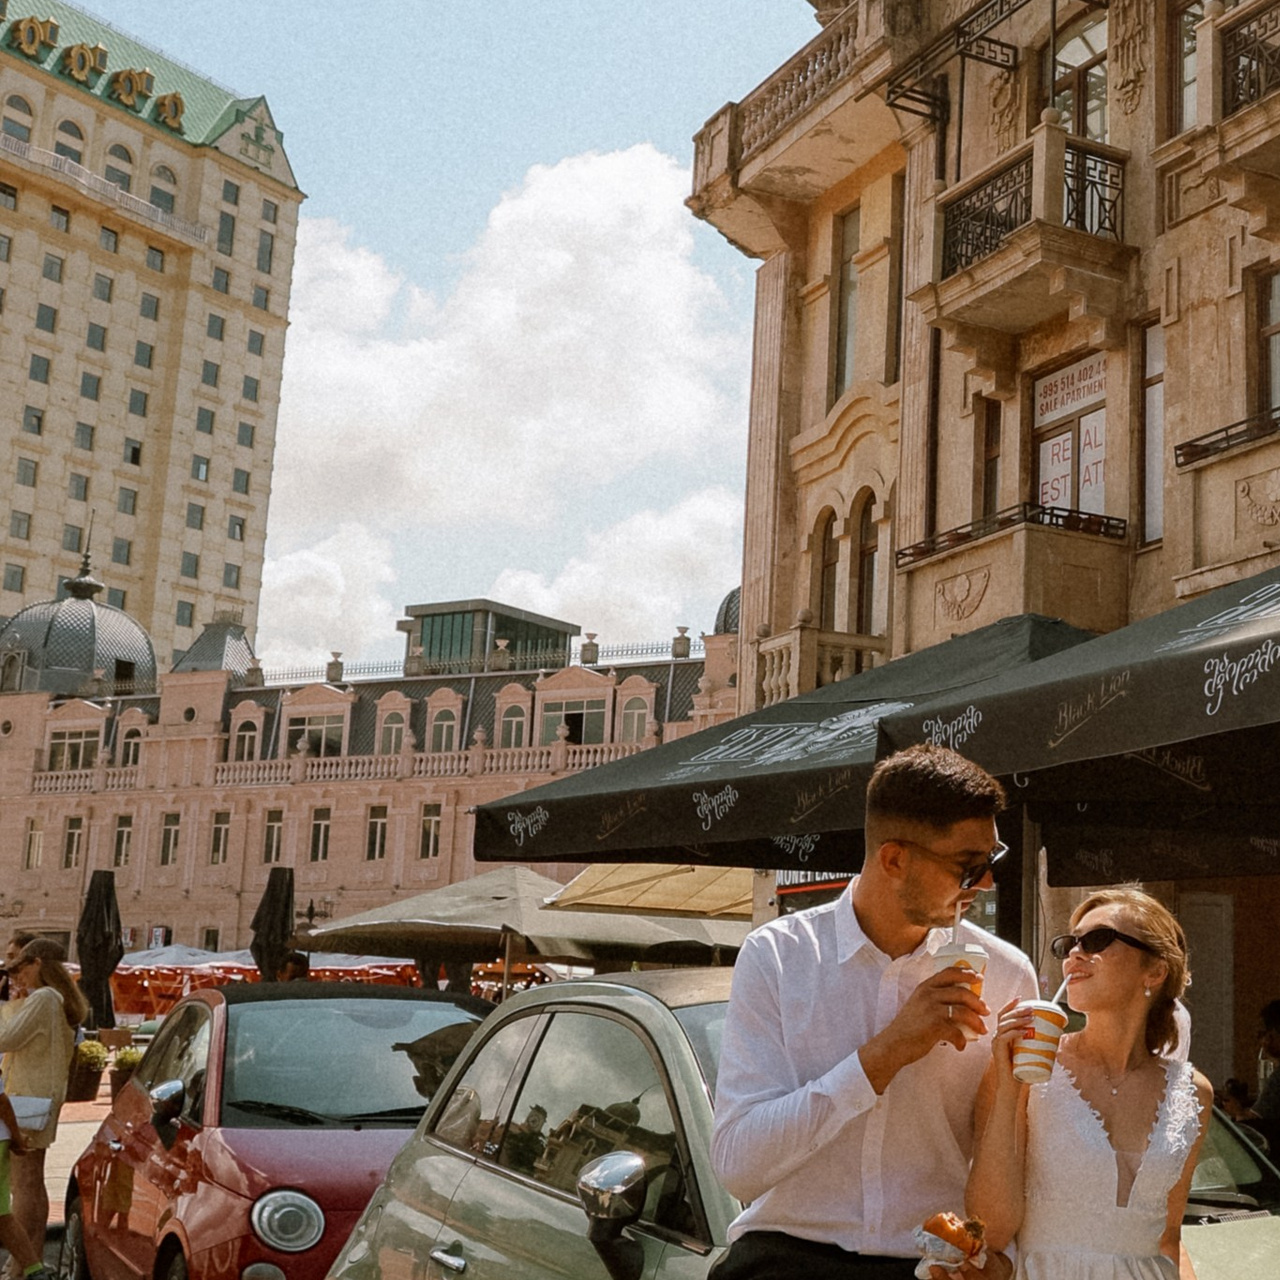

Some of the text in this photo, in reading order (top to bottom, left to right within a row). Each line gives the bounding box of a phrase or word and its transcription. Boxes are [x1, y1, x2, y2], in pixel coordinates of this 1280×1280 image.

[1060, 373, 1075, 392] 514
[1077, 365, 1094, 383] 402
[1039, 397, 1058, 418] SALE
[1082, 459, 1106, 490] AT
[1054, 670, 1130, 737] Black Lion
